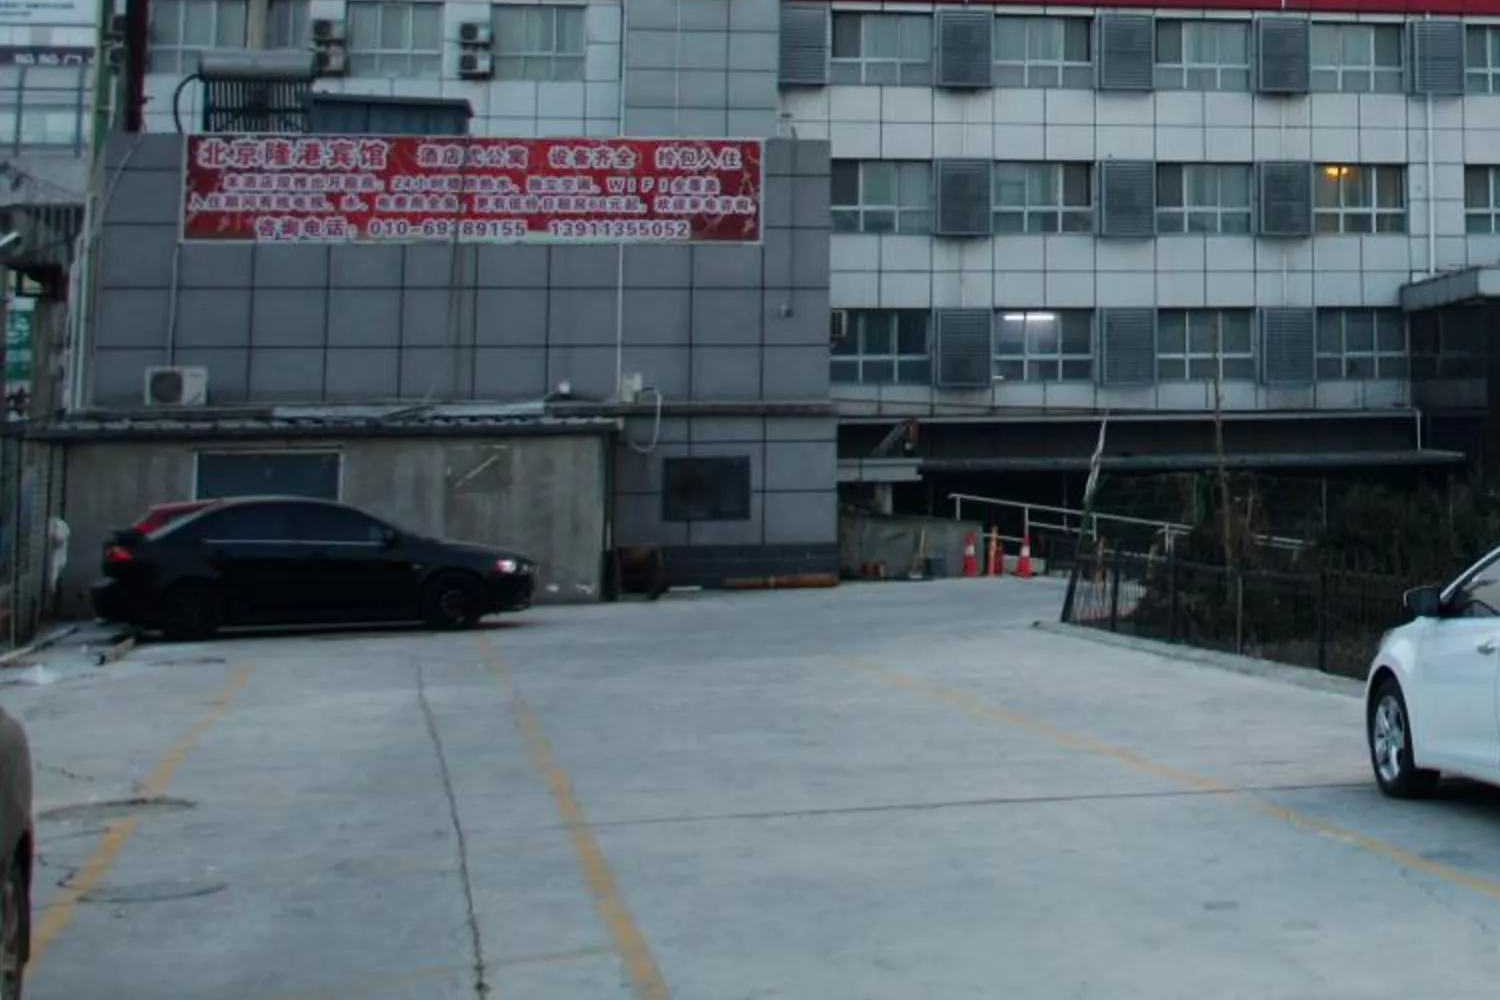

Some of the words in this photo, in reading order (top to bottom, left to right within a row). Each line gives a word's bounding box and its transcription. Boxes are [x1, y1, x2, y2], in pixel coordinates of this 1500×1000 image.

[198, 138, 388, 169] 北京隆港宾馆
[655, 145, 742, 169] 拎包入住
[548, 219, 691, 239] 13911355052
